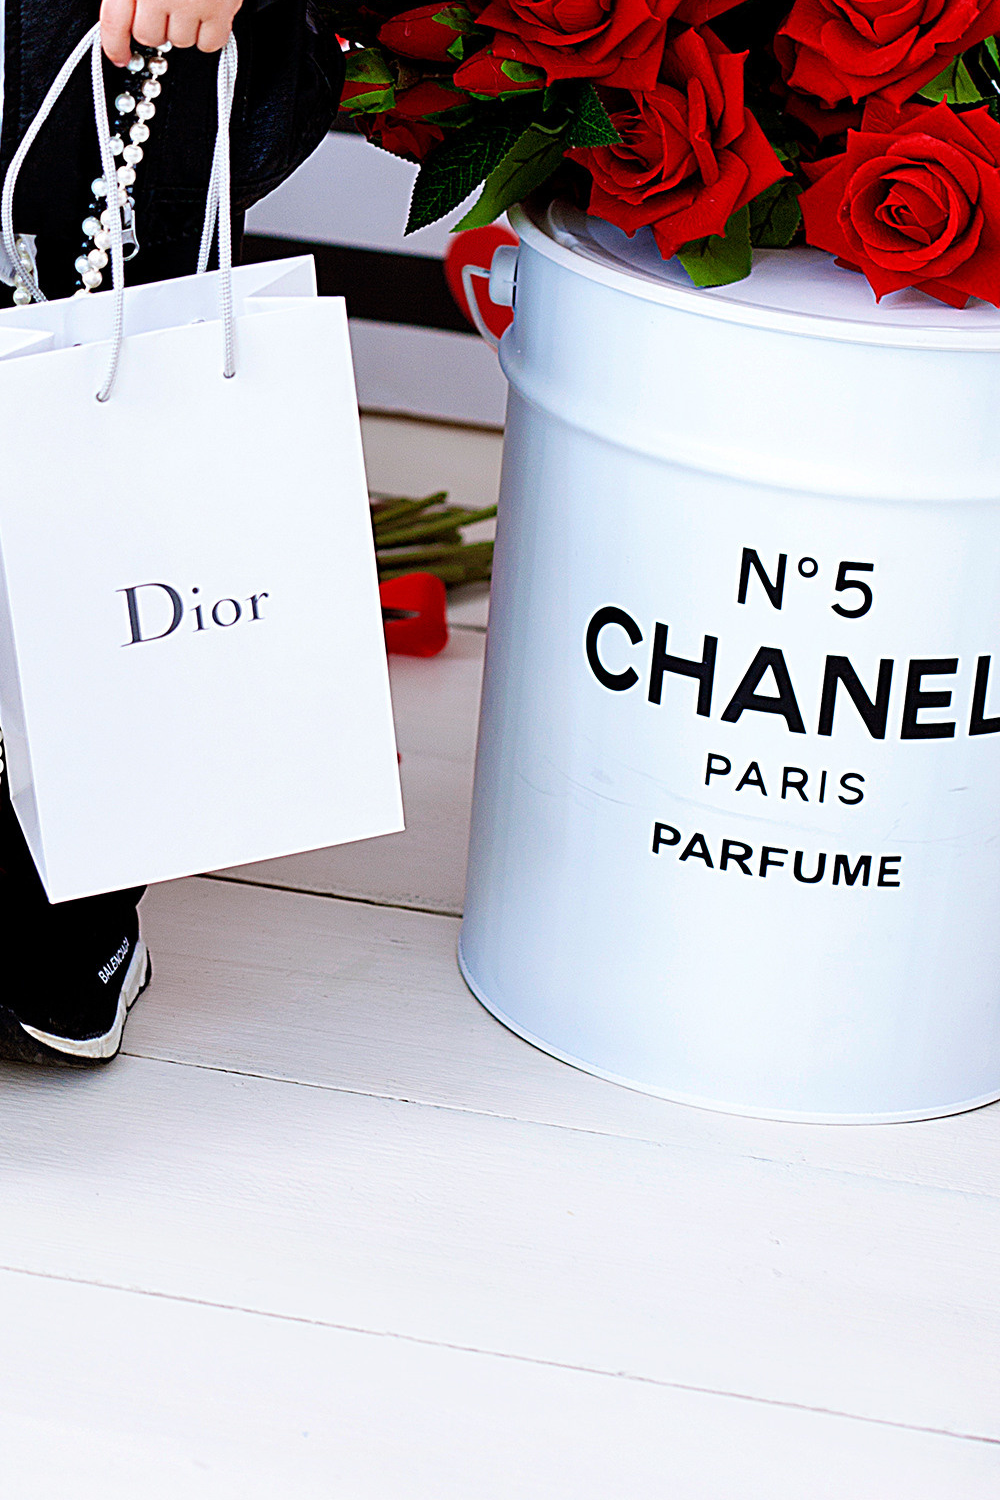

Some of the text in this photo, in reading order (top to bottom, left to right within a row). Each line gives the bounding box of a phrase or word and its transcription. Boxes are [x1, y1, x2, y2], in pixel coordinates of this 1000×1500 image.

[115, 582, 270, 647] Dior
[585, 605, 1000, 740] CHANEL
[704, 752, 867, 806] PARIS
[651, 821, 903, 888] PARFUME
